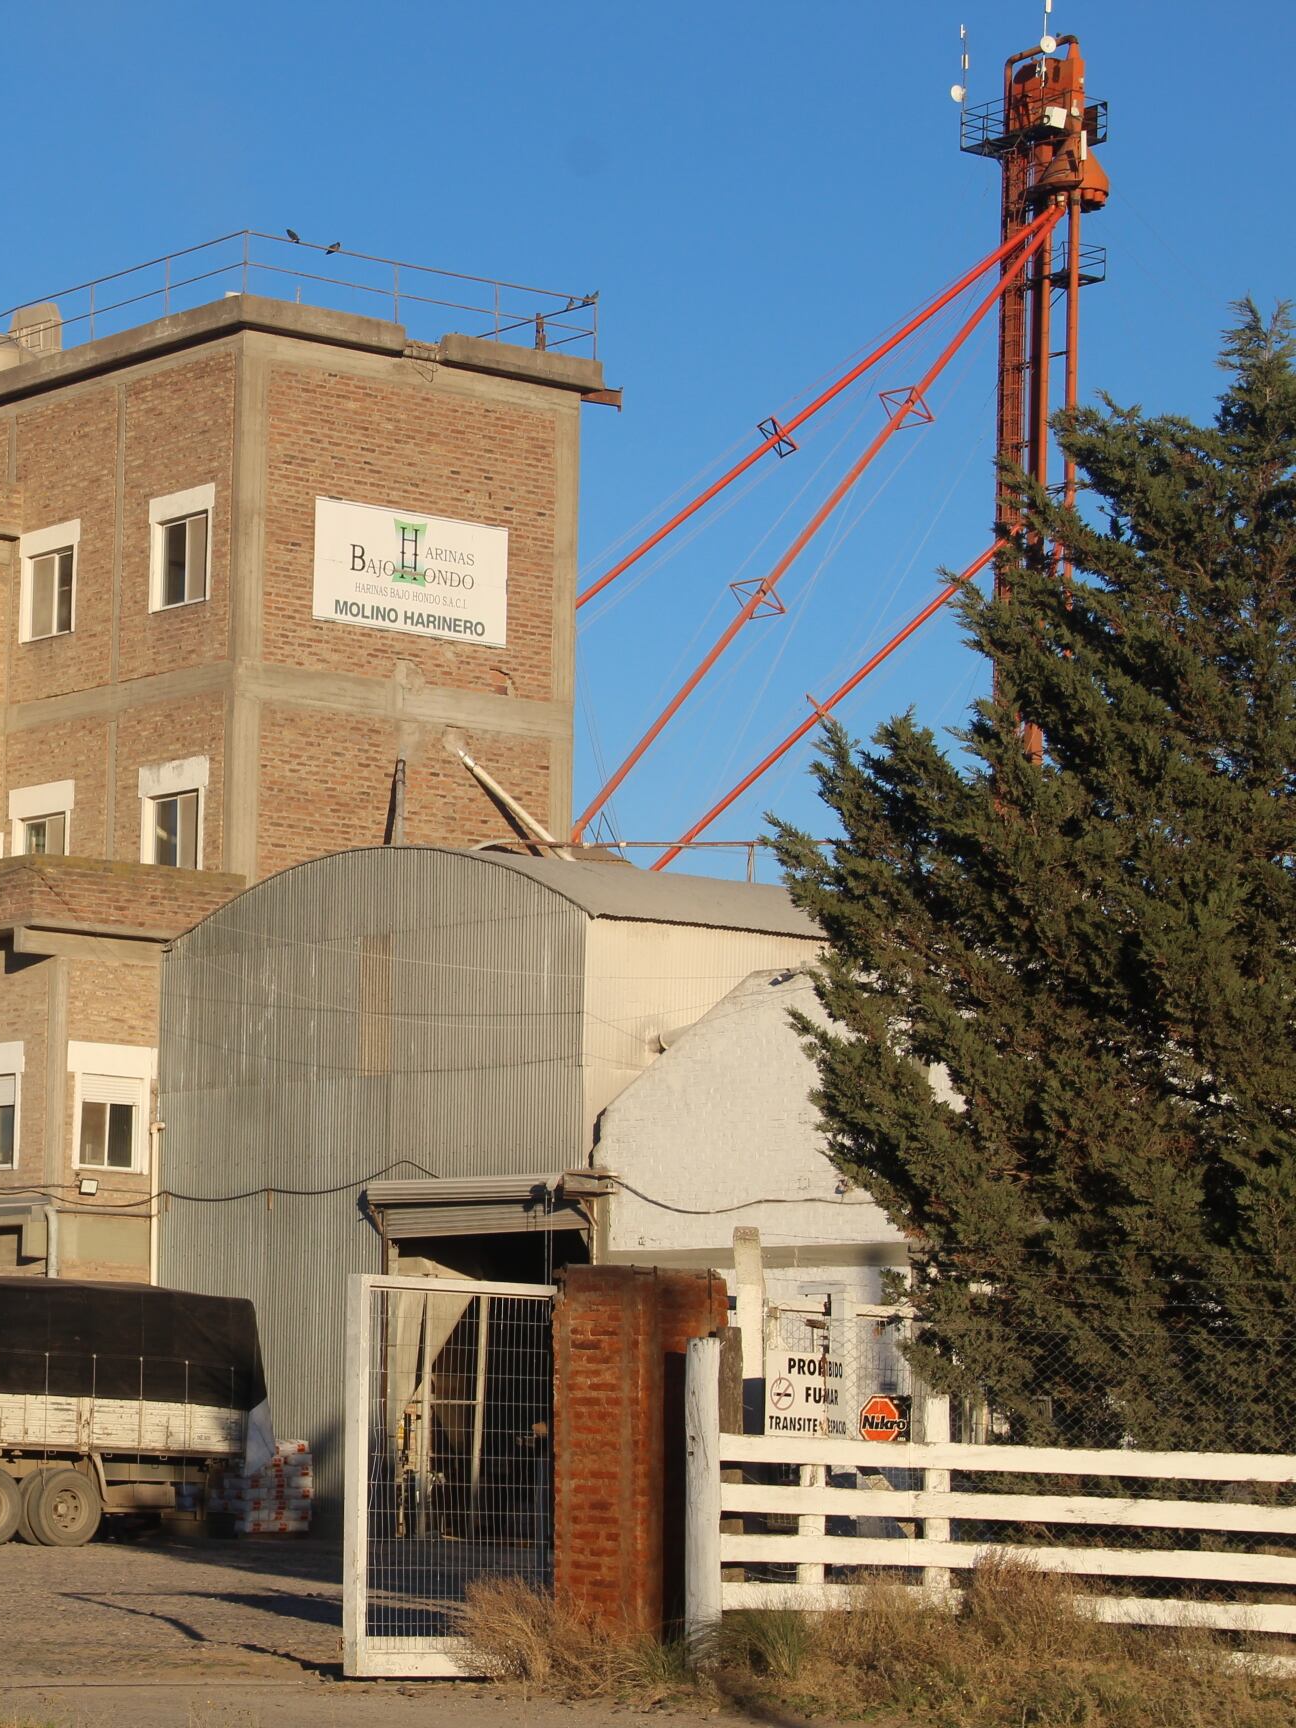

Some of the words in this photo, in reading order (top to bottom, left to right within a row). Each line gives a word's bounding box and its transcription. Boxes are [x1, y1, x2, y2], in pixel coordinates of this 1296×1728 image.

[355, 581, 389, 597] HARINAS
[389, 588, 410, 601] BAJO
[412, 591, 441, 606] HONDO
[334, 599, 398, 623] MOLINO
[403, 610, 486, 637] HARINERO
[805, 1386, 839, 1406] FUMAR
[768, 1415, 818, 1433] TRANSITE
[861, 1414, 907, 1431] Nikro
